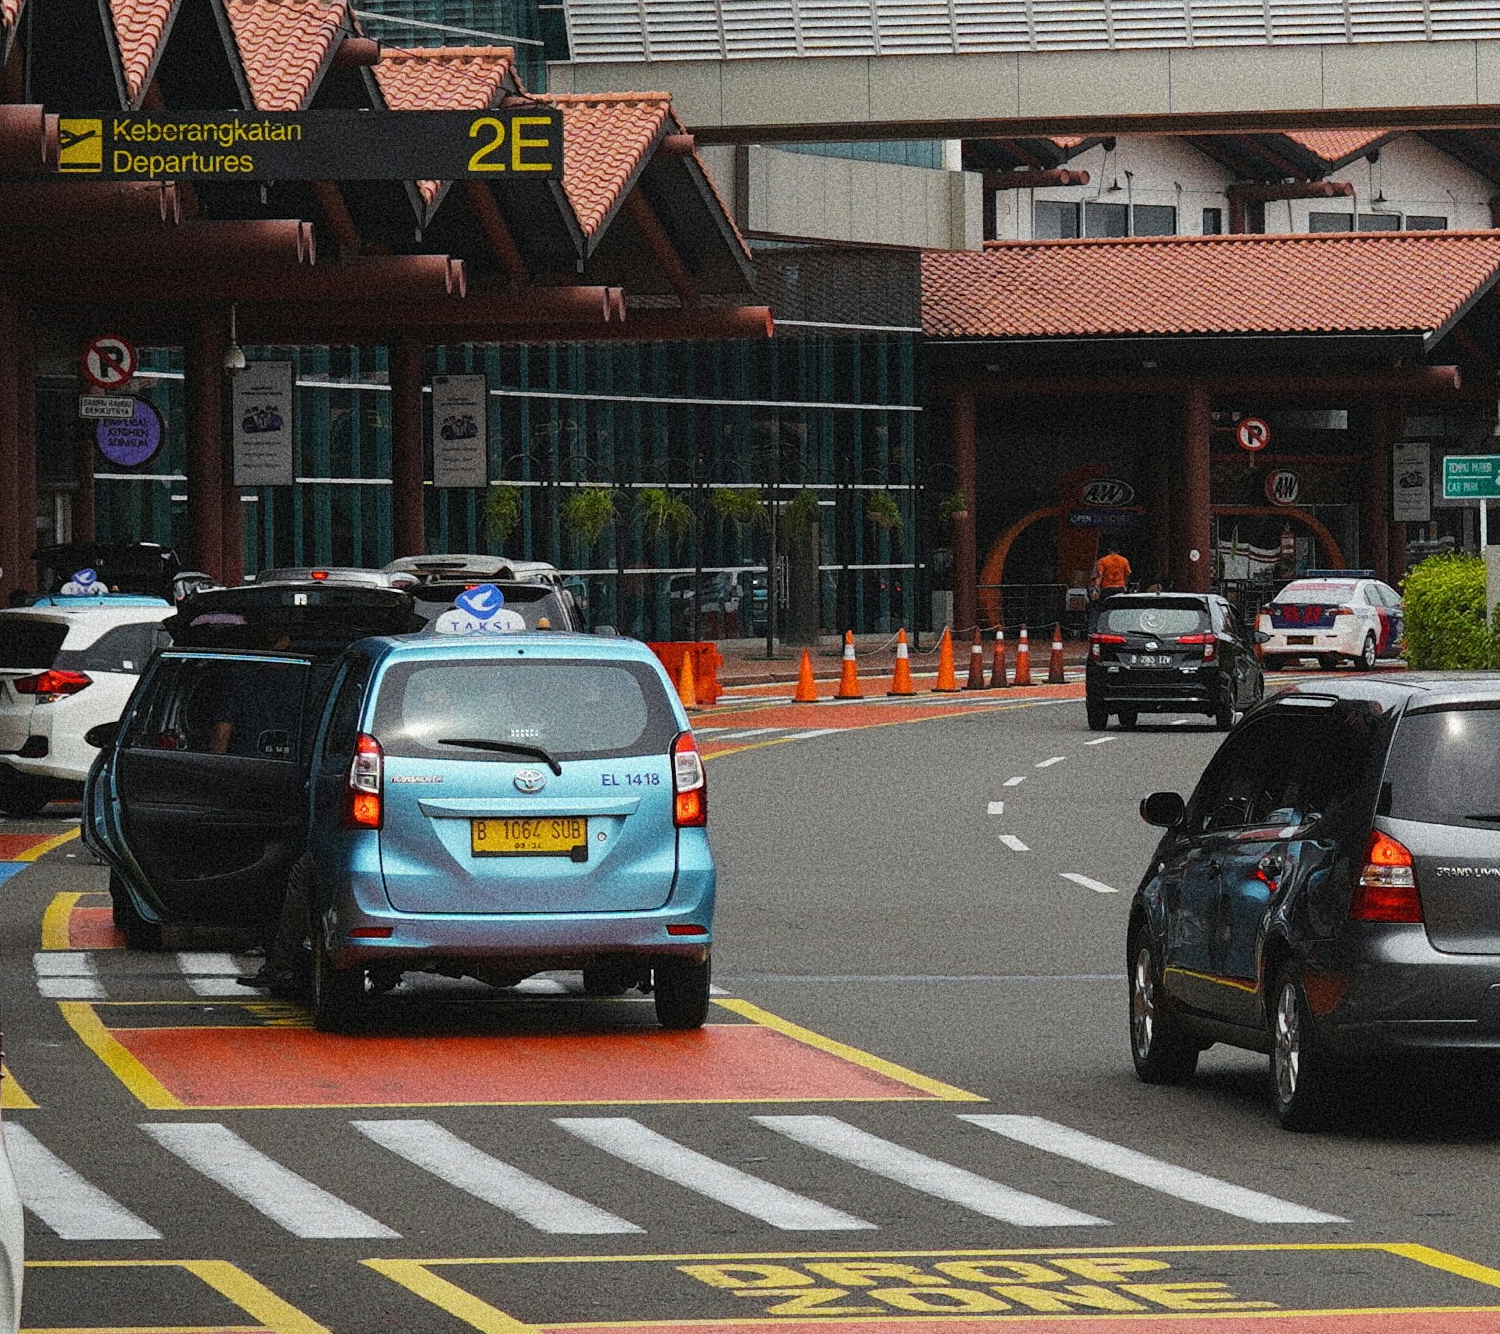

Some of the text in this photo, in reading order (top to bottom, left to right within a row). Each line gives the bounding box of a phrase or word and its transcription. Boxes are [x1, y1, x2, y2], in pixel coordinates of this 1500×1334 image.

[113, 116, 553, 172] Keberangkatan 2E
[113, 150, 254, 175] Departures
[1447, 482, 1479, 492] CAR PARK
[451, 621, 511, 632] TAKSI
[601, 772, 660, 786] EL 1418
[476, 818, 581, 841] B 1064 SUB
[1436, 866, 1473, 878] GRAND
[675, 1258, 1172, 1289] DROP
[734, 1281, 1281, 1317] ZONE
